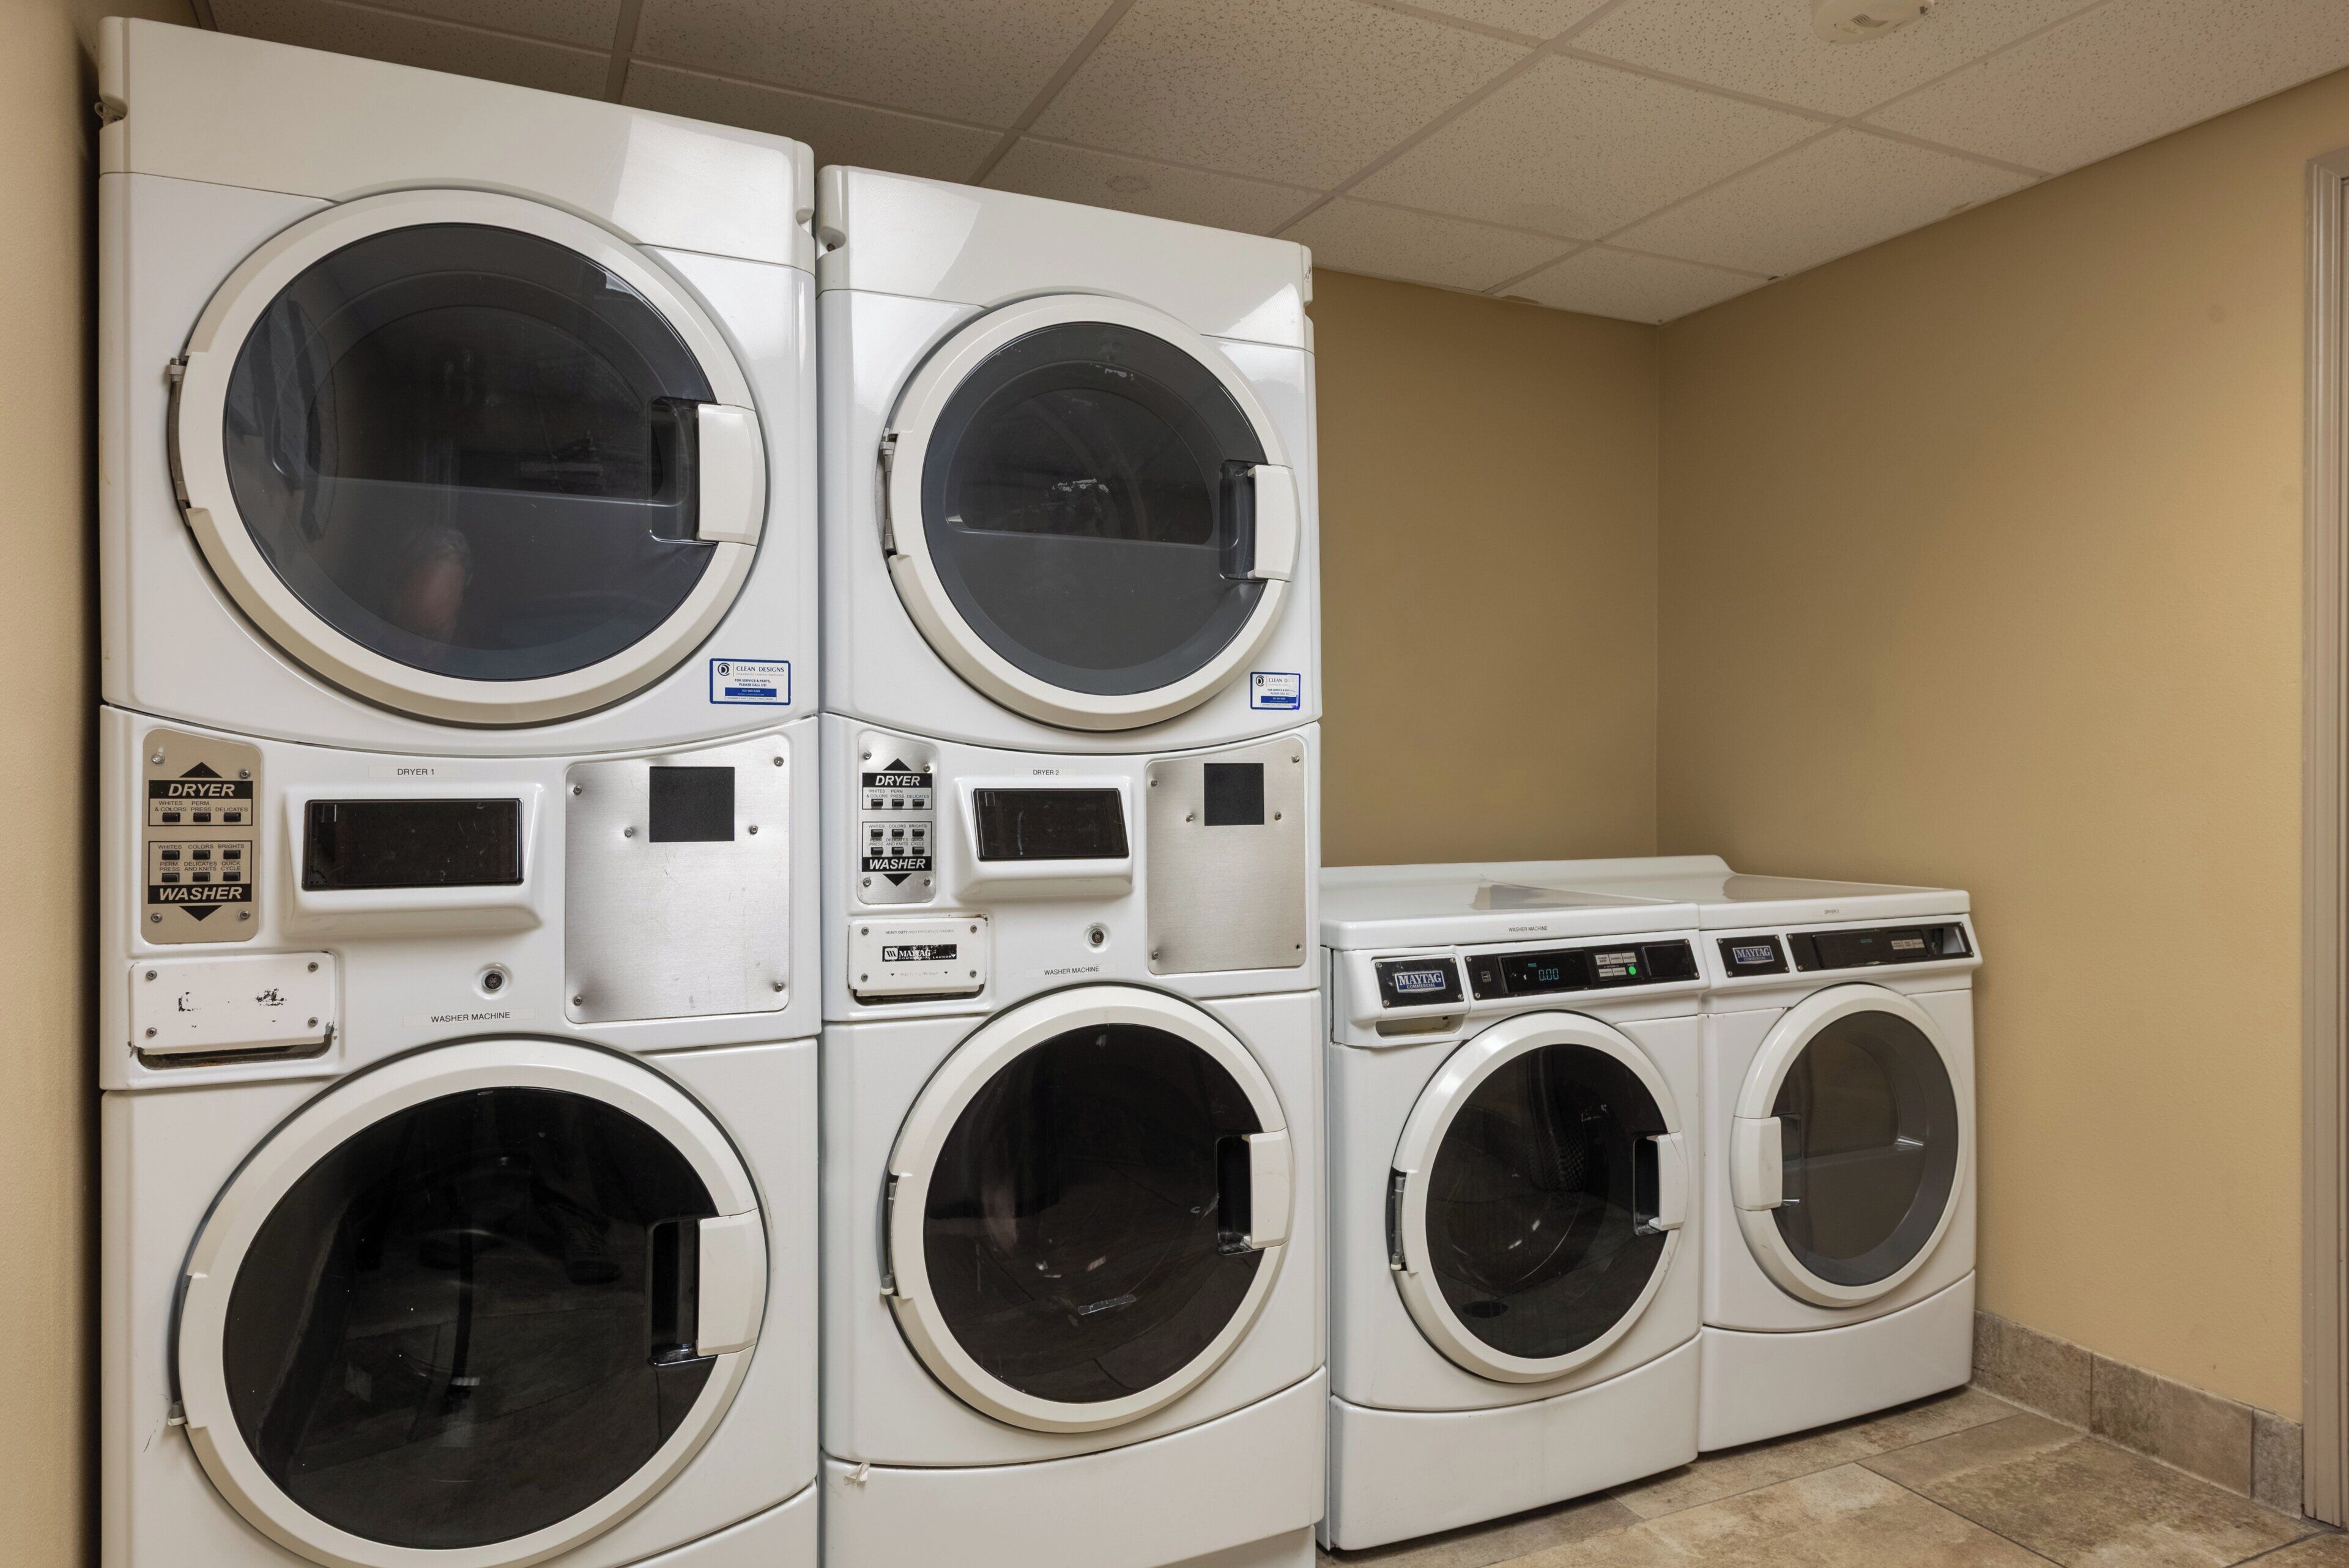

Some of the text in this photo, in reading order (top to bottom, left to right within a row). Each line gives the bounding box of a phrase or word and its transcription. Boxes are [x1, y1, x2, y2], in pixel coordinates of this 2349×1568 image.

[875, 775, 921, 786] DRYER
[168, 784, 235, 797] DRYER
[869, 858, 926, 869] WASHER
[159, 886, 243, 901] WASHER
[1736, 948, 1770, 958] MAYTAG
[1398, 973, 1442, 986] MAYTAG
[1538, 968, 1559, 981] 0.00
[431, 1011, 510, 1023] WASHER MACHINE
